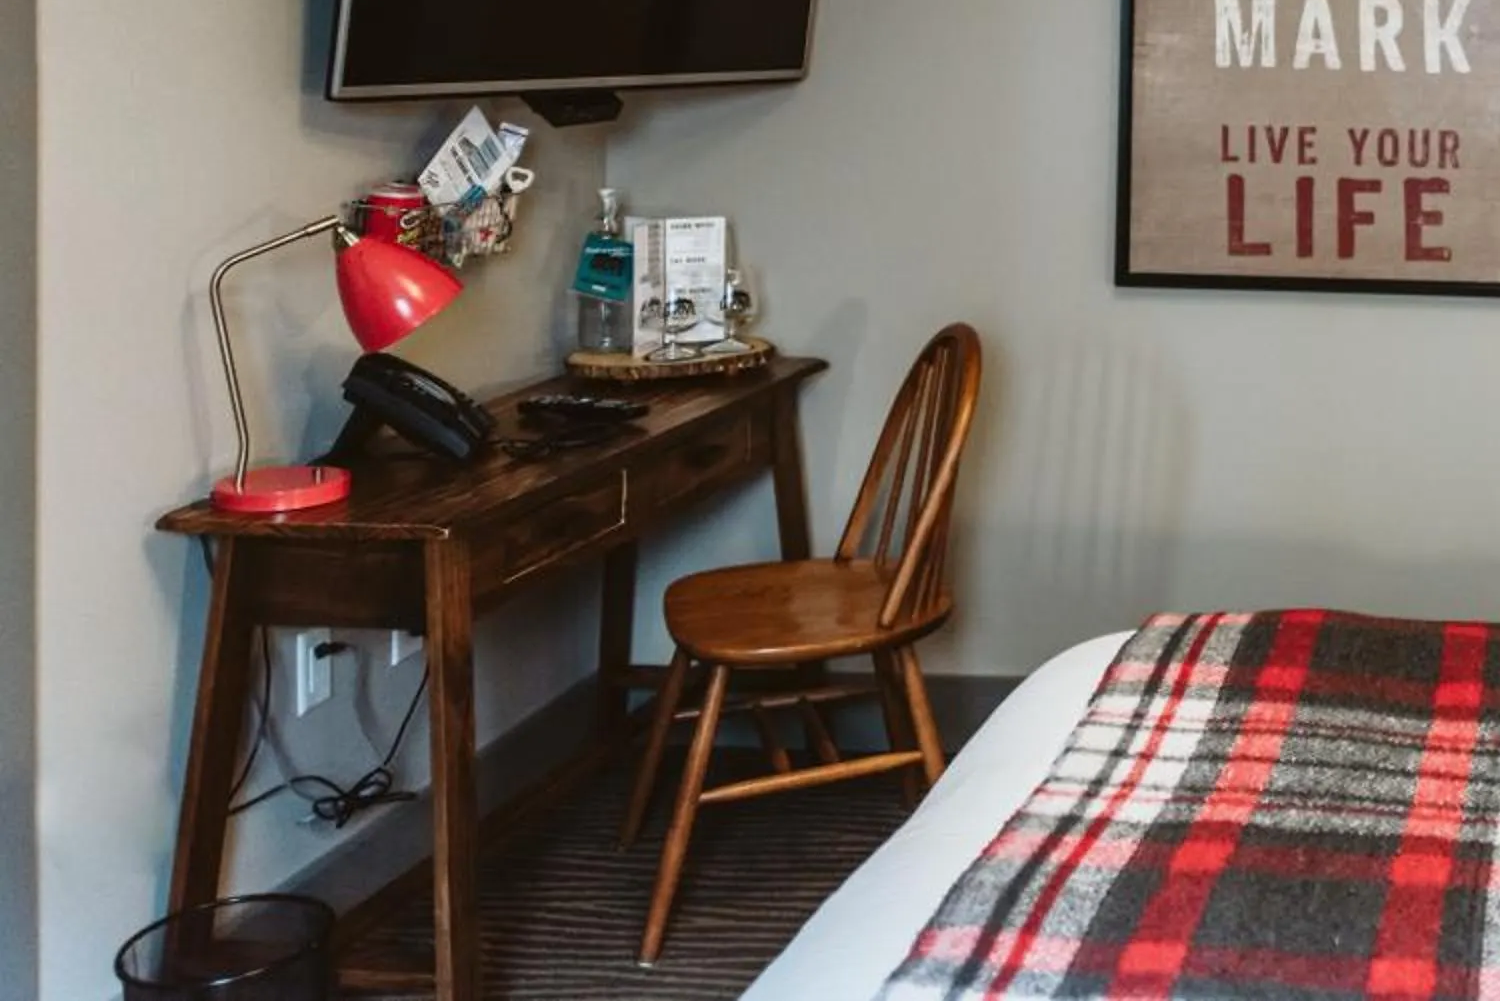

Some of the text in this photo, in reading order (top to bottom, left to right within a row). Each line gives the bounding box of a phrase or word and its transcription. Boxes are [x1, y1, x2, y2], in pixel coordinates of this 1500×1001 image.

[1220, 125, 1461, 169] LIVE YOUR
[1226, 174, 1452, 262] LIFE
